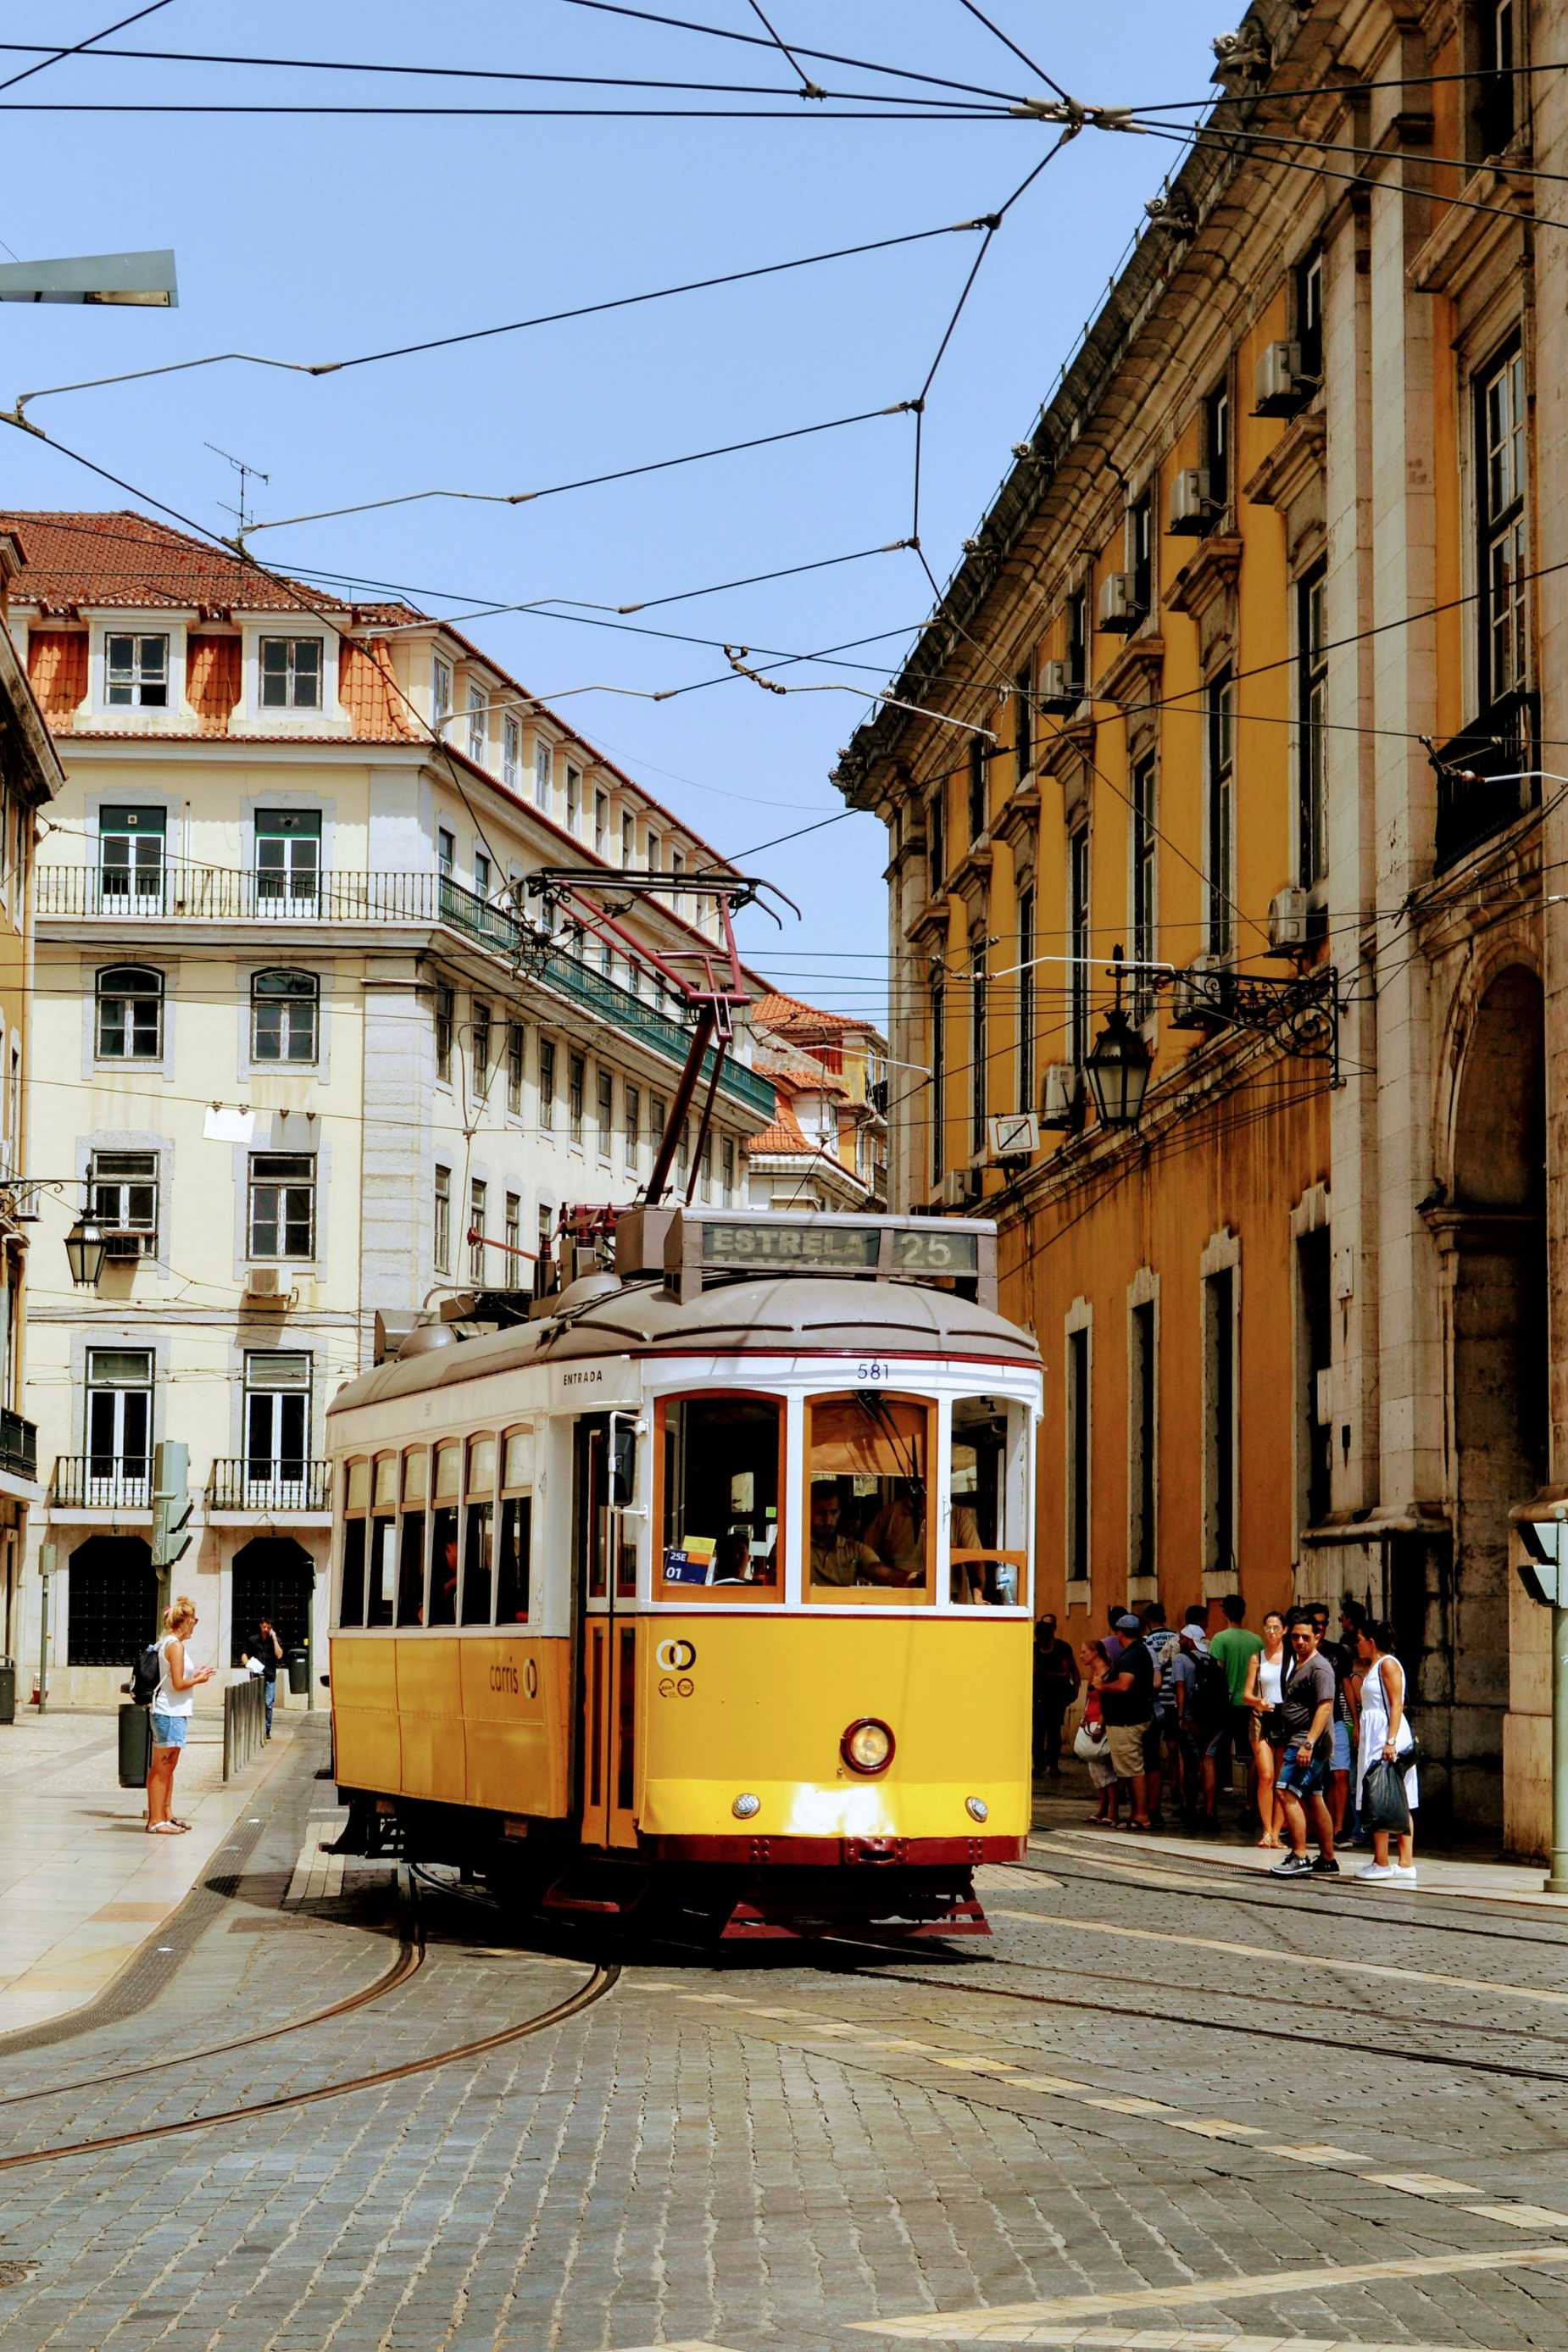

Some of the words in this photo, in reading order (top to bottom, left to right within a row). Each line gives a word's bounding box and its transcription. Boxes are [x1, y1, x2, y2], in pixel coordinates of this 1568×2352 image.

[1004, 1122, 1024, 1140] 15
[714, 1228, 867, 1258] ESTRELA
[901, 1232, 951, 1266] 25
[563, 1370, 603, 1385] ENTRADA
[857, 1363, 888, 1380] 581
[670, 1552, 687, 1562] 25E
[665, 1566, 682, 1580] 01
[489, 1655, 519, 1694] carris
